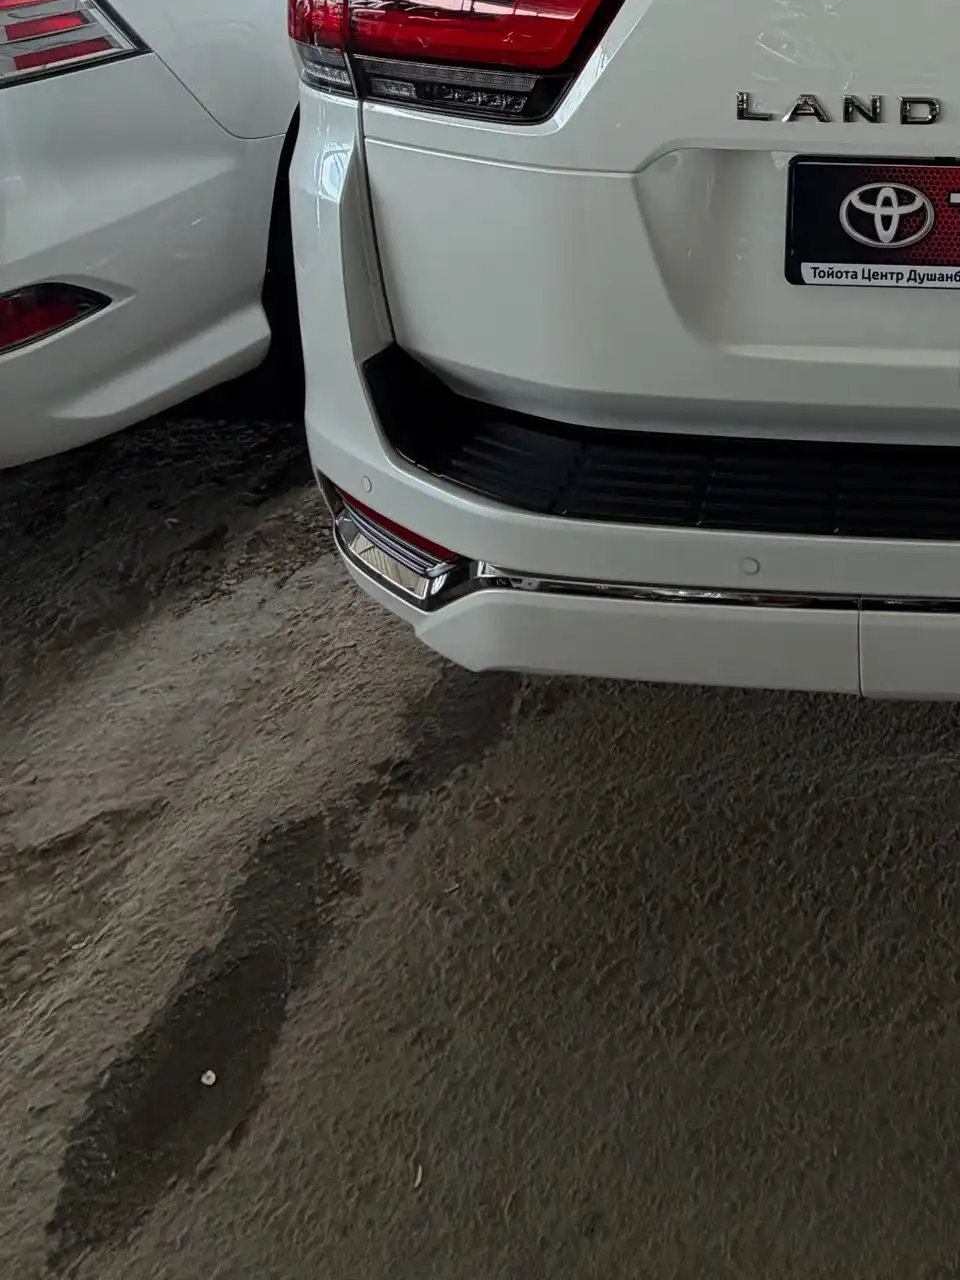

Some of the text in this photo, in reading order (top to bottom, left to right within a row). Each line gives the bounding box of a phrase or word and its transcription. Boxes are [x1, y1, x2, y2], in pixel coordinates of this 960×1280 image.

[736, 91, 941, 125] LAND
[810, 266, 858, 281] Тойота
[861, 268, 905, 285] Центр
